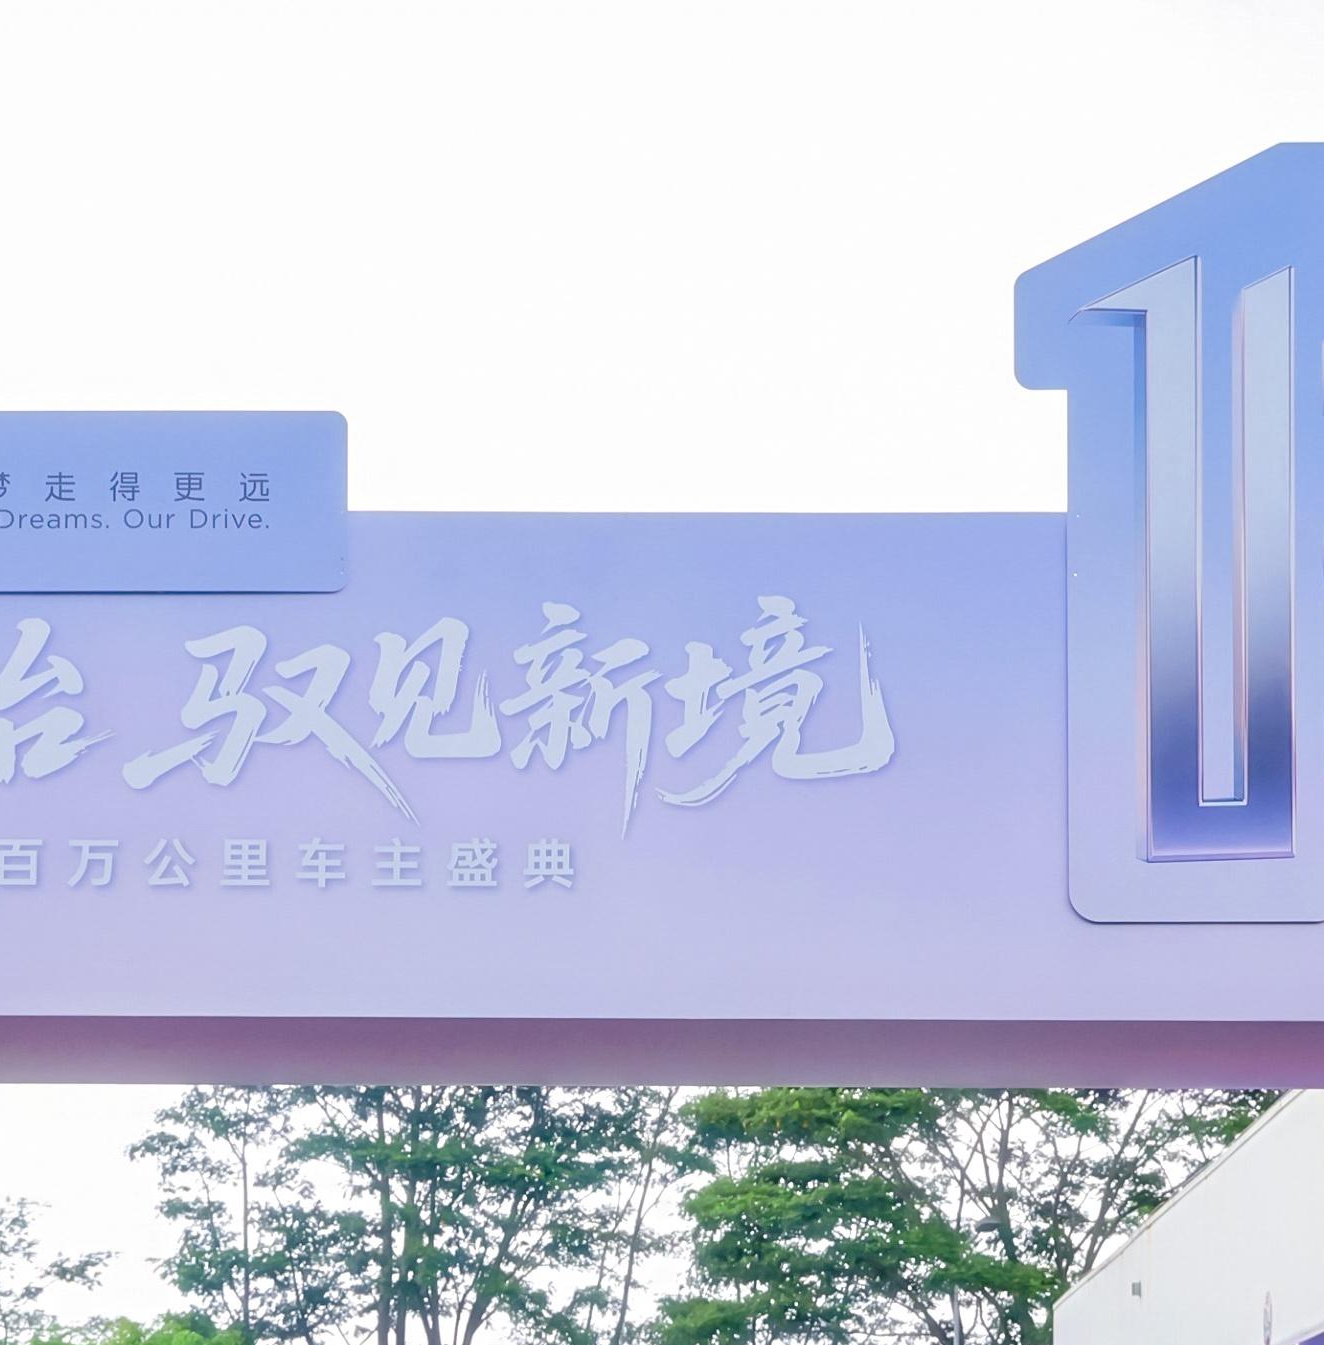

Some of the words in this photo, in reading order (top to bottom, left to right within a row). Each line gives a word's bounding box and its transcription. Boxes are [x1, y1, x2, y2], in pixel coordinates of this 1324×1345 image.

[123, 508, 177, 531] Our
[189, 508, 271, 532] Drive.
[123, 595, 897, 840] 驭见新境
